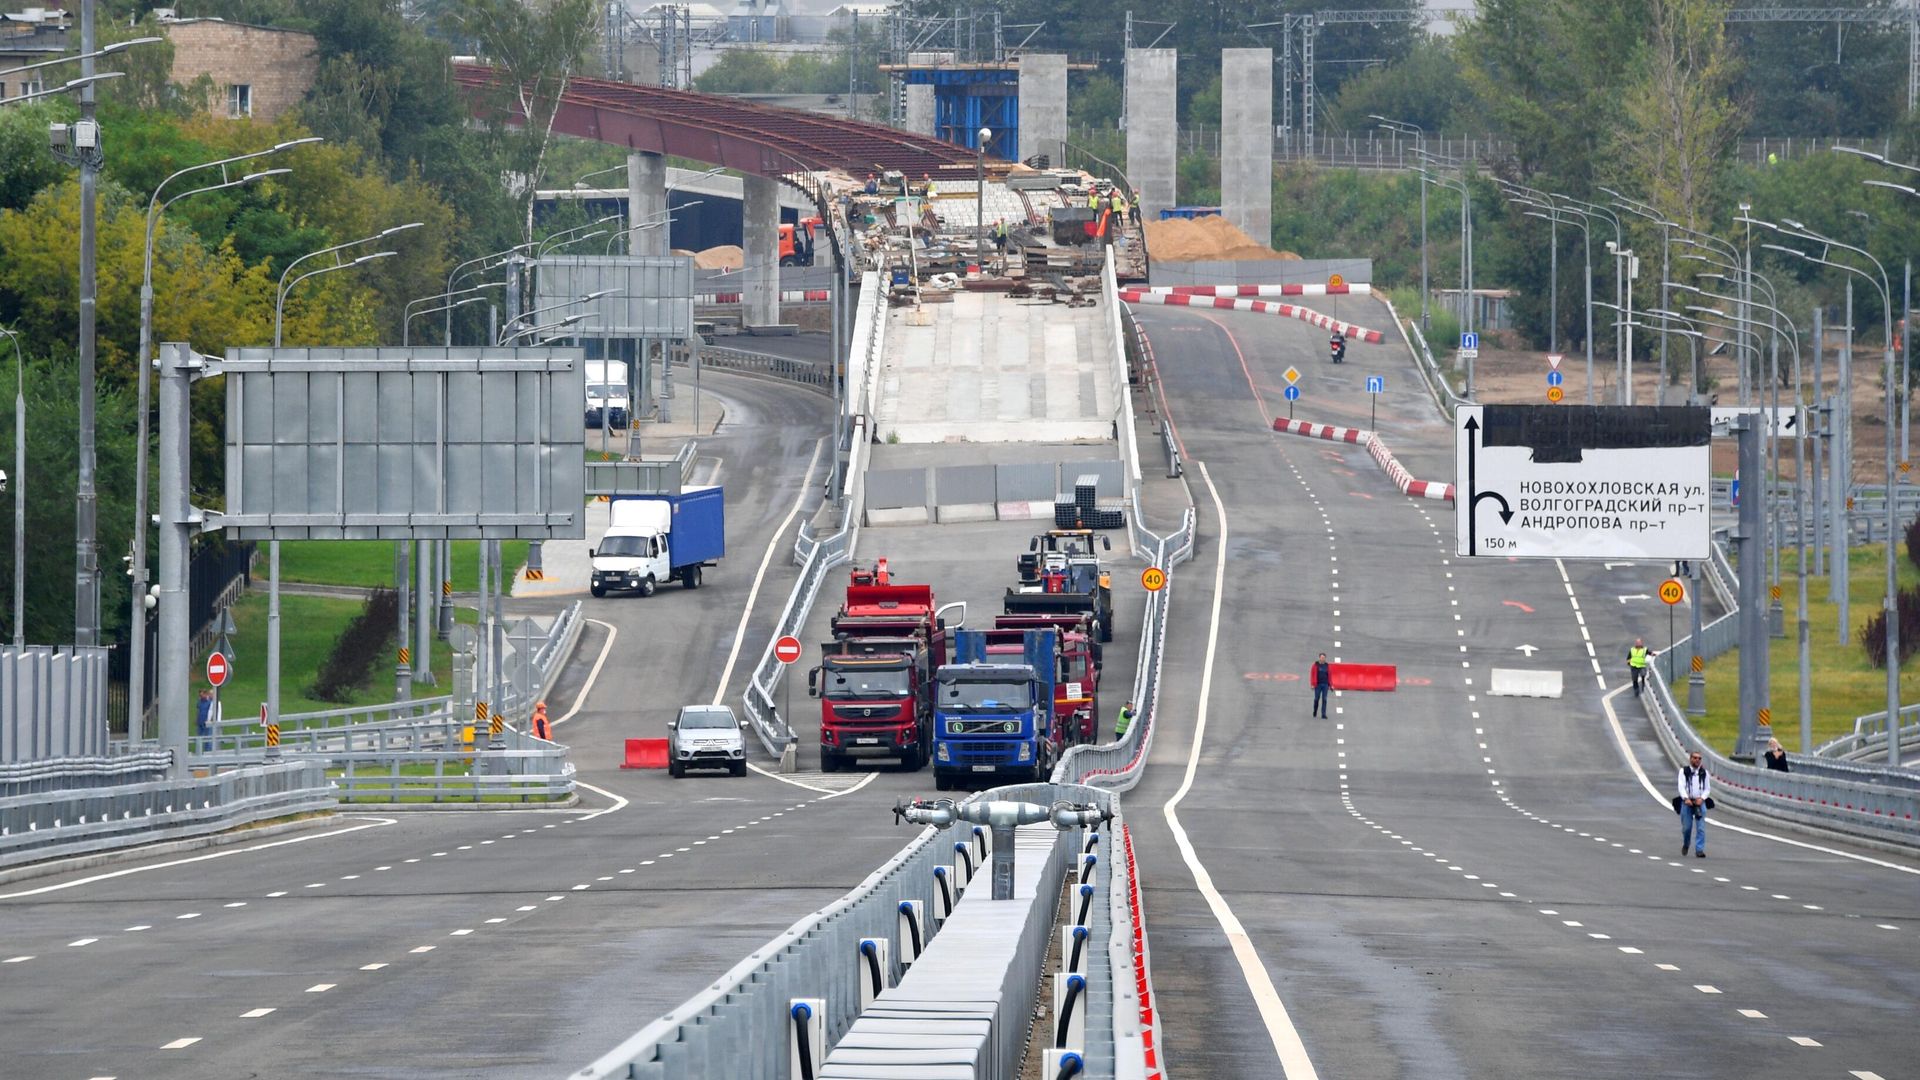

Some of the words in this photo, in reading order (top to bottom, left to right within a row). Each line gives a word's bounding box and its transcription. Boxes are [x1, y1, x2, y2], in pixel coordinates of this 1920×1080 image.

[1520, 481, 1679, 495] НОВОХОХЛОВСКАЯ
[1683, 484, 1705, 498] ул.
[1520, 497, 1662, 514] ВОЛГОГРАДСКИЙ
[1668, 502, 1705, 516] пр-т
[1521, 516, 1623, 530] АНДРОПОВА
[1629, 519, 1667, 533] пр-т
[1484, 537, 1505, 549] 150
[1507, 540, 1517, 549] м
[1145, 574, 1161, 585] 40
[1663, 587, 1679, 598] 40
